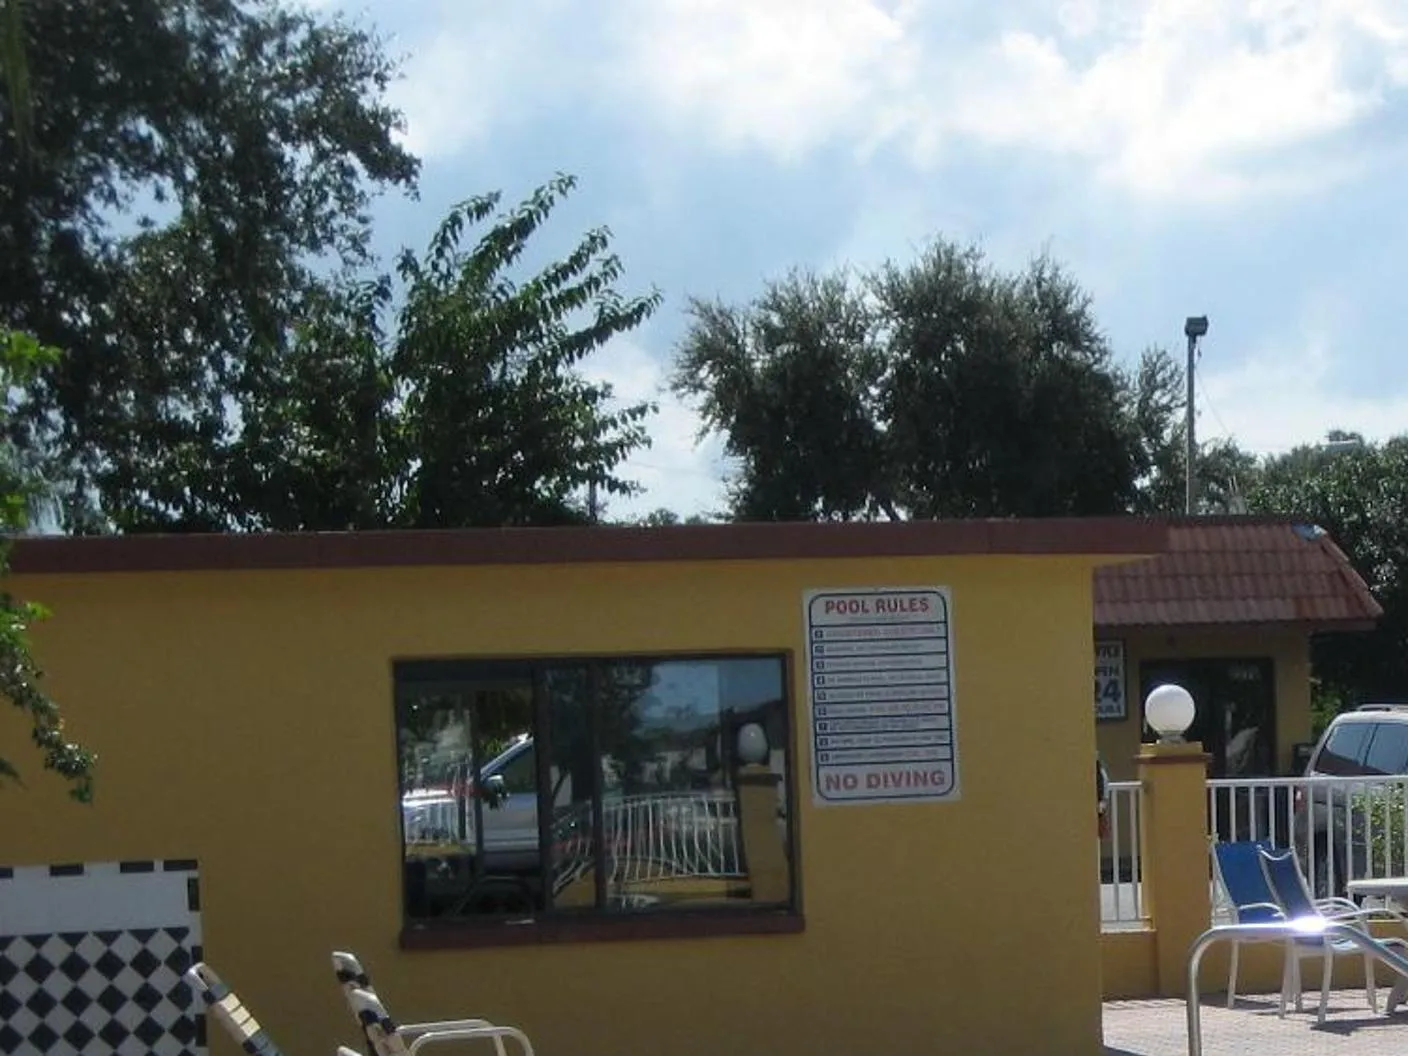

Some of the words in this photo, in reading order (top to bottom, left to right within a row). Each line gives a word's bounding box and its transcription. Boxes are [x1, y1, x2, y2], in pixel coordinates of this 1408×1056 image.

[824, 599, 870, 615] POOL
[875, 597, 930, 613] RULES
[825, 772, 859, 791] NO
[865, 769, 946, 790] DIVING
